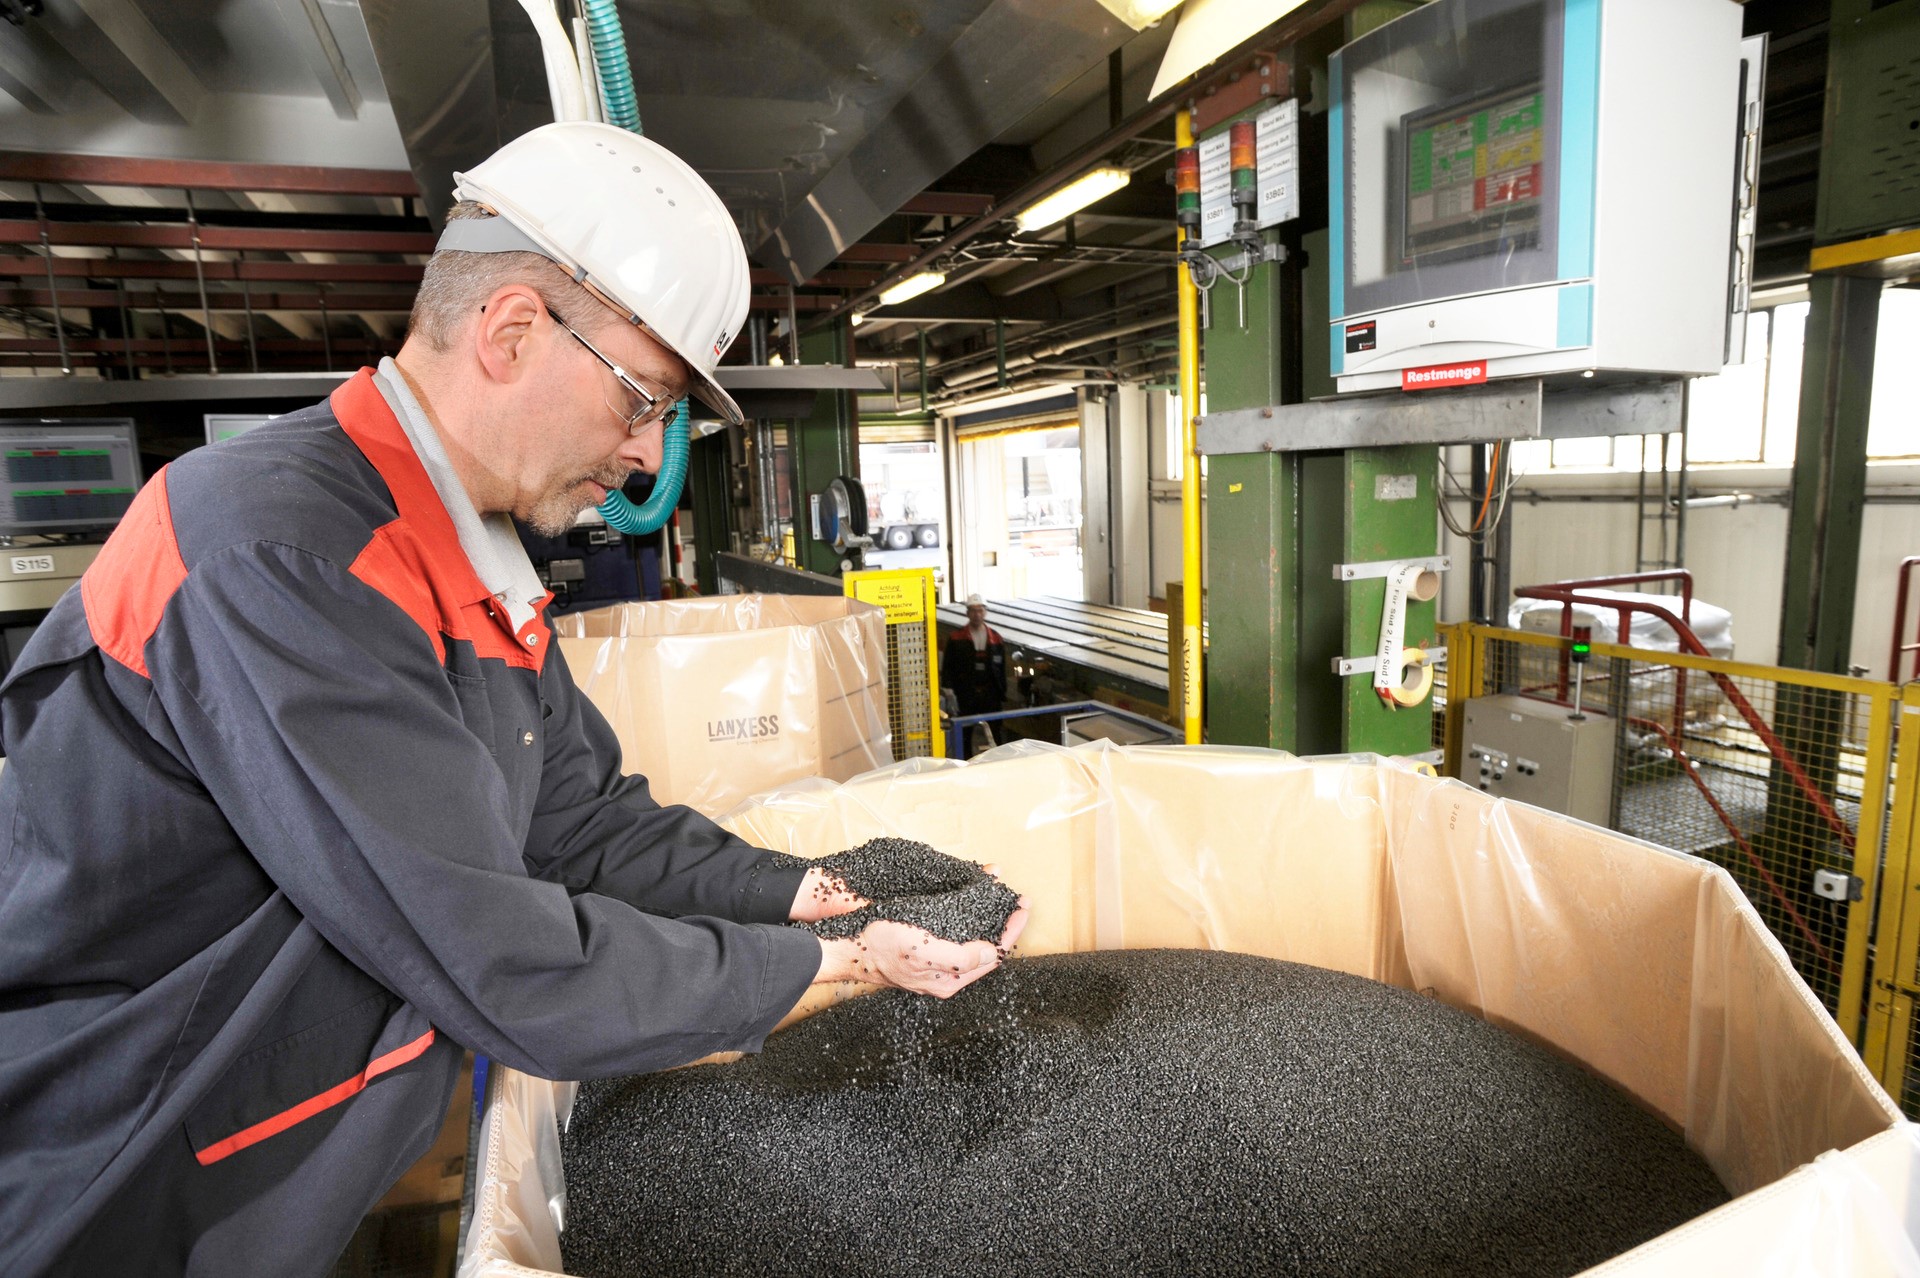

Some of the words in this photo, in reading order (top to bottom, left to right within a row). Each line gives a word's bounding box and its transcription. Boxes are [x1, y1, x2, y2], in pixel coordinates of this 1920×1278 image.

[1265, 187, 1284, 201] 93B02
[1407, 366, 1480, 383] Restmenge
[708, 714, 779, 739] LANXESS
